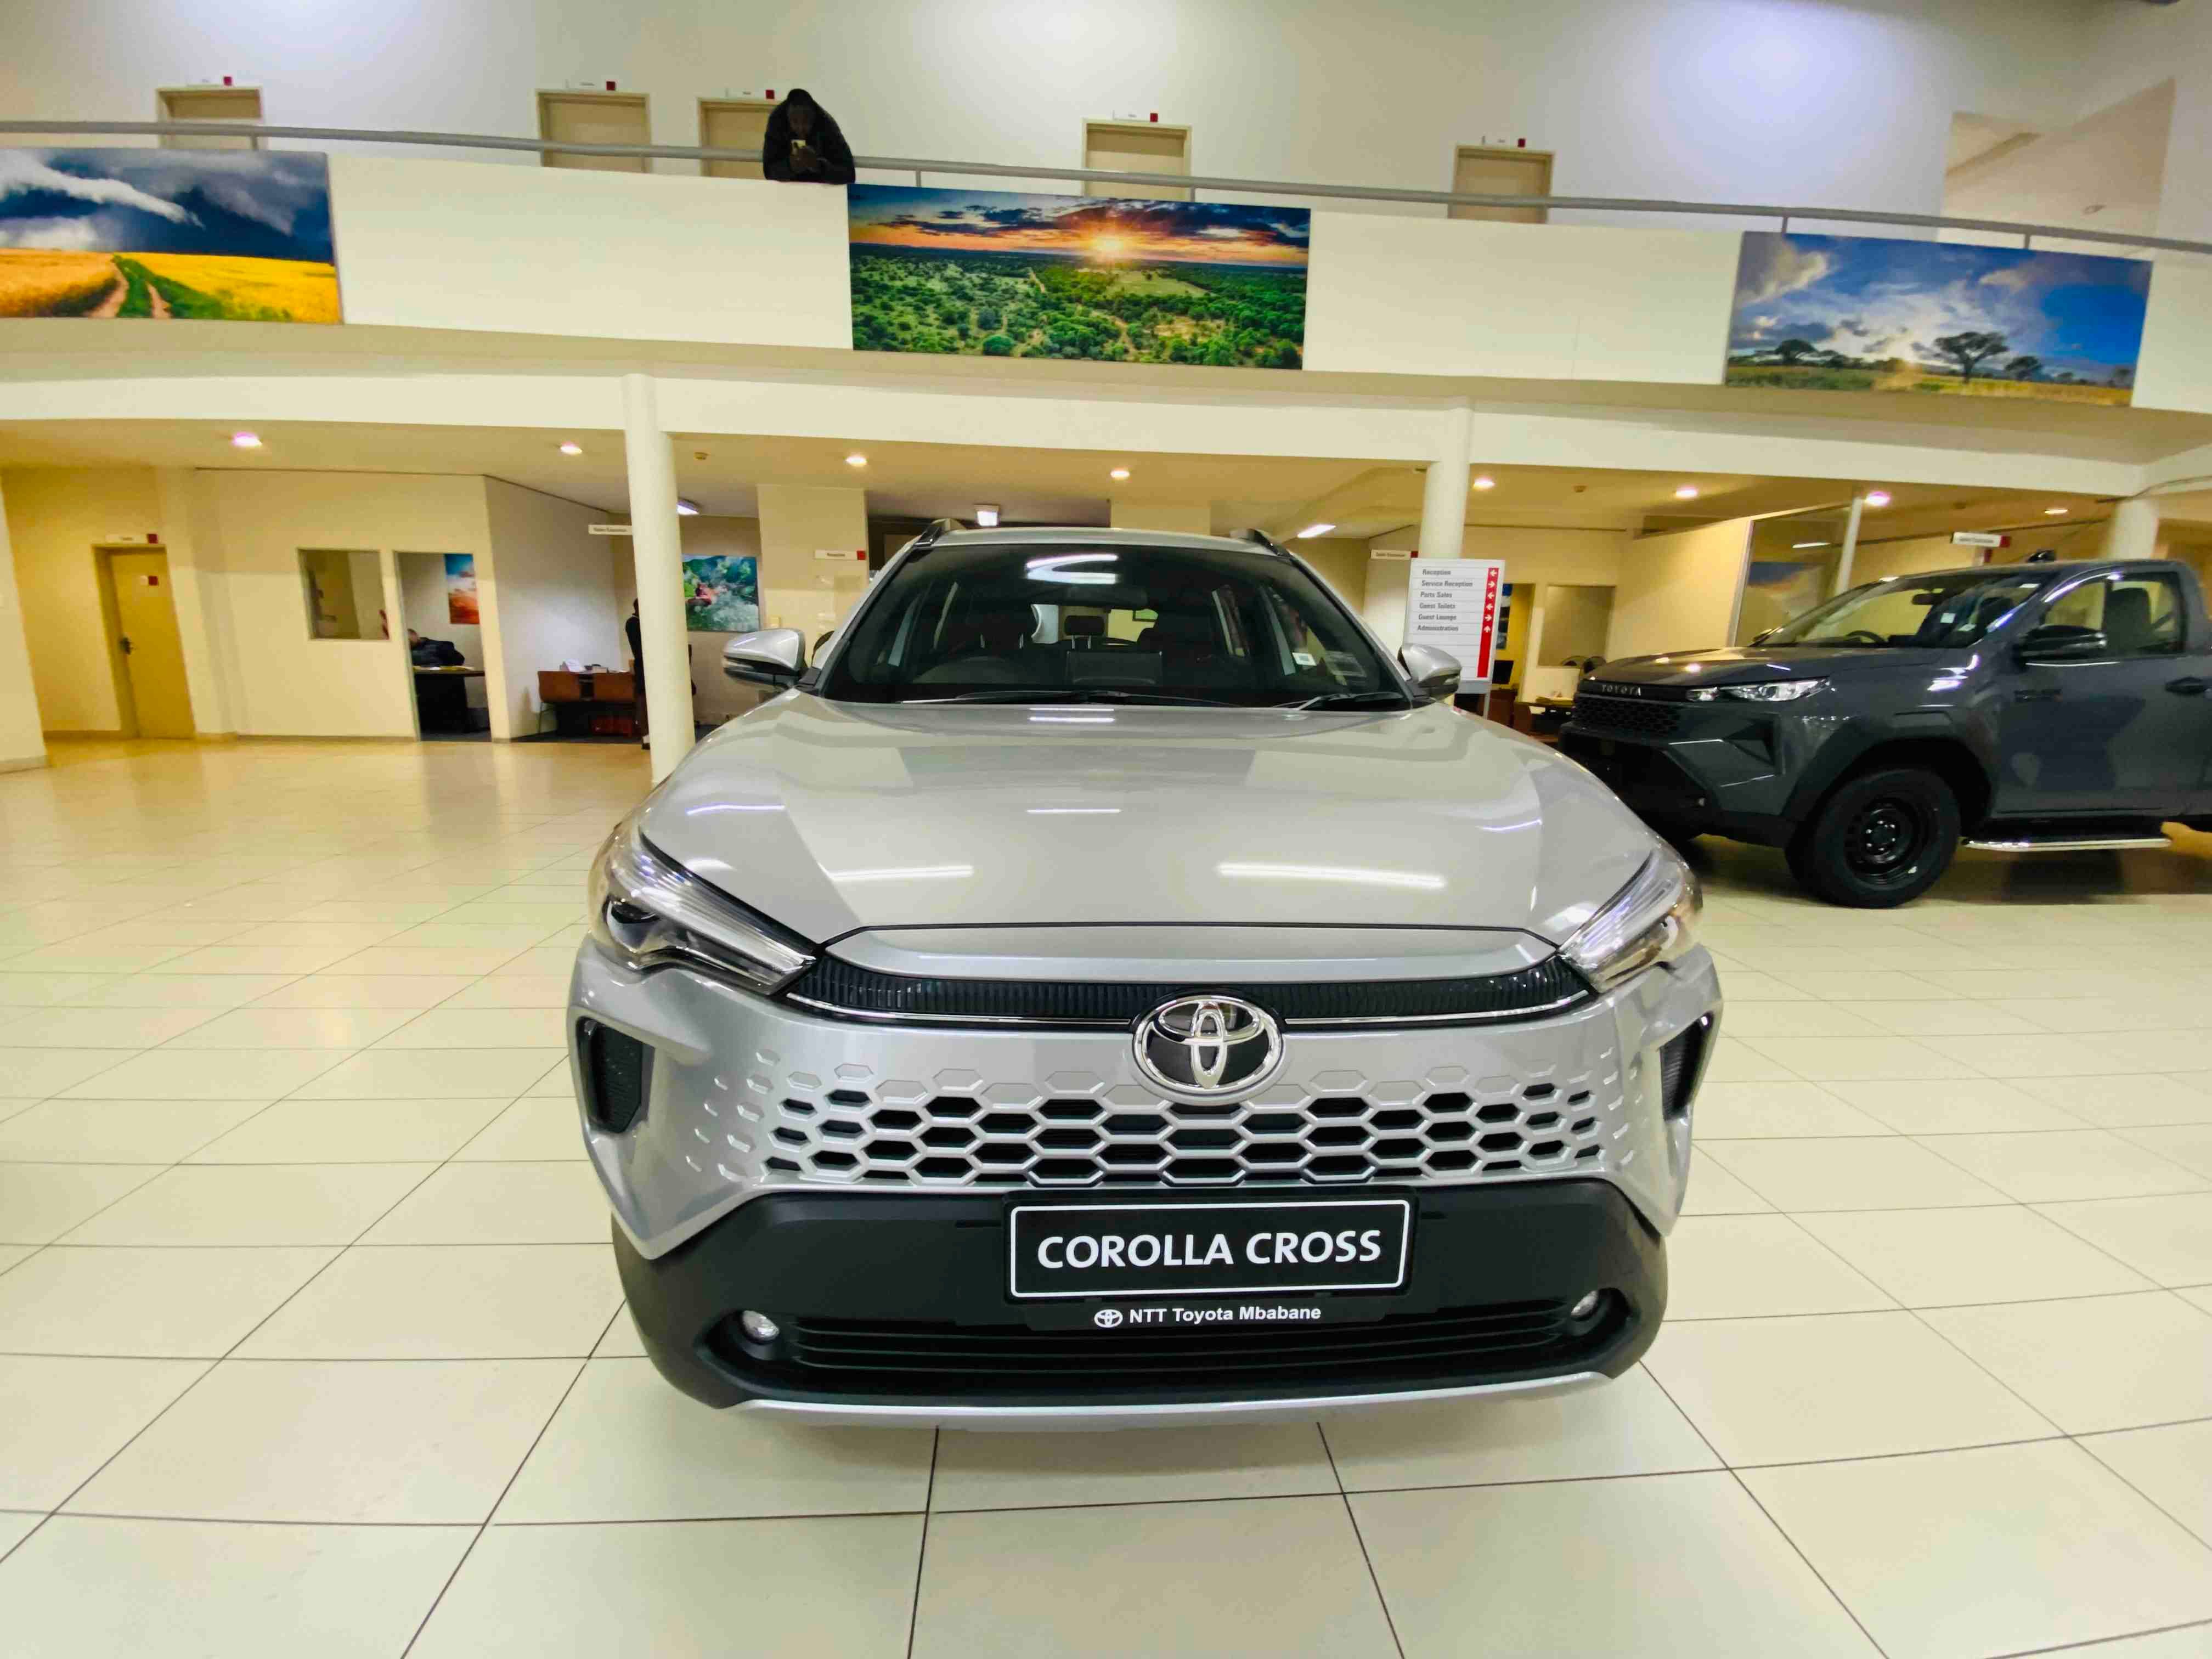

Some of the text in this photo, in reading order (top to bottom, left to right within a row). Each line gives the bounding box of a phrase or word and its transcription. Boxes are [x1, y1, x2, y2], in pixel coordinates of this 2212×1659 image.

[1601, 684, 1641, 696] TOYOTA
[1037, 1230, 1381, 1268] COROLLA CROSS
[1129, 1306, 1321, 1325] NTT Toyota Mbabane
